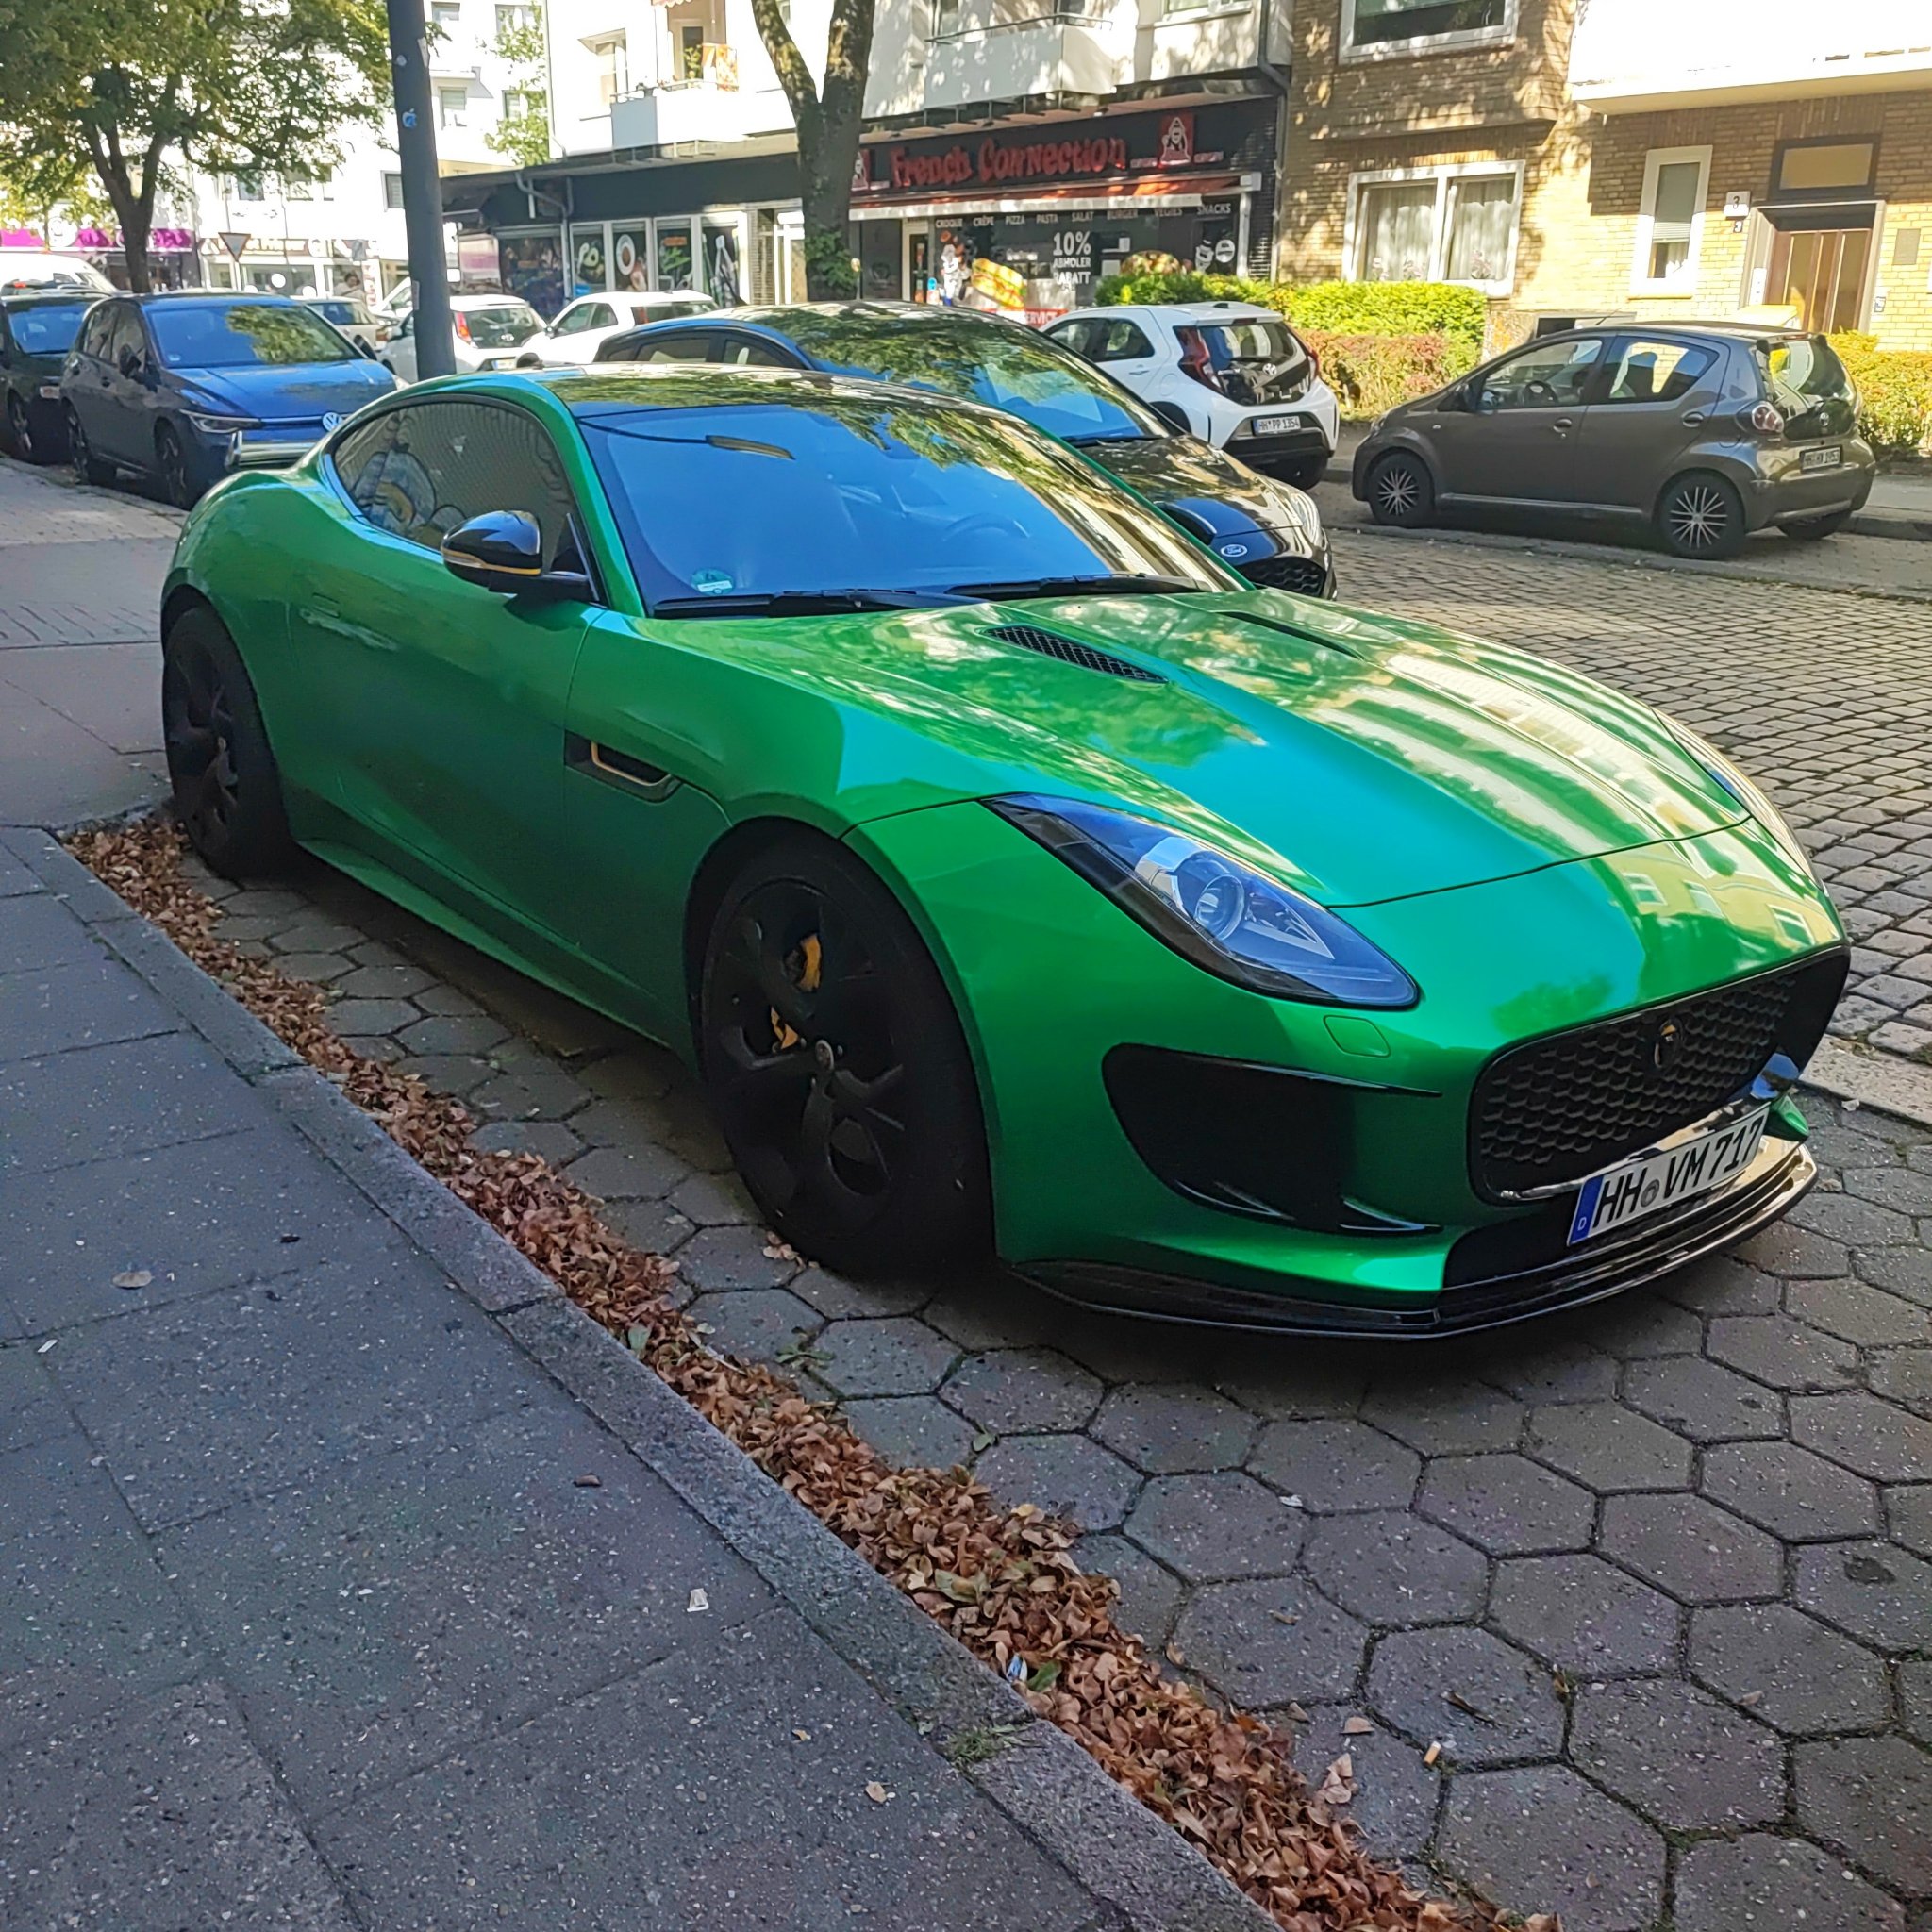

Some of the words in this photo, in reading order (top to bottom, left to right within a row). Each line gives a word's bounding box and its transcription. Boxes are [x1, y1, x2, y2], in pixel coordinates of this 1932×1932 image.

[890, 145, 973, 188] French
[978, 137, 1127, 183] Connection
[1005, 215, 1025, 225] PIZZA
[1036, 214, 1058, 224] PASTA
[1072, 211, 1094, 222] SALAT
[1107, 209, 1138, 220] BURGER
[1196, 203, 1231, 215] SNACKS
[1052, 231, 1091, 256] 10%
[1052, 257, 1091, 269] ABHOLER
[1052, 271, 1091, 285] RABATT
[1283, 418, 1299, 428] 1354
[1577, 1216, 1587, 1231] D
[1592, 1167, 1648, 1228] HH
[1663, 1141, 1711, 1199] VM
[1708, 1115, 1765, 1181] 717
